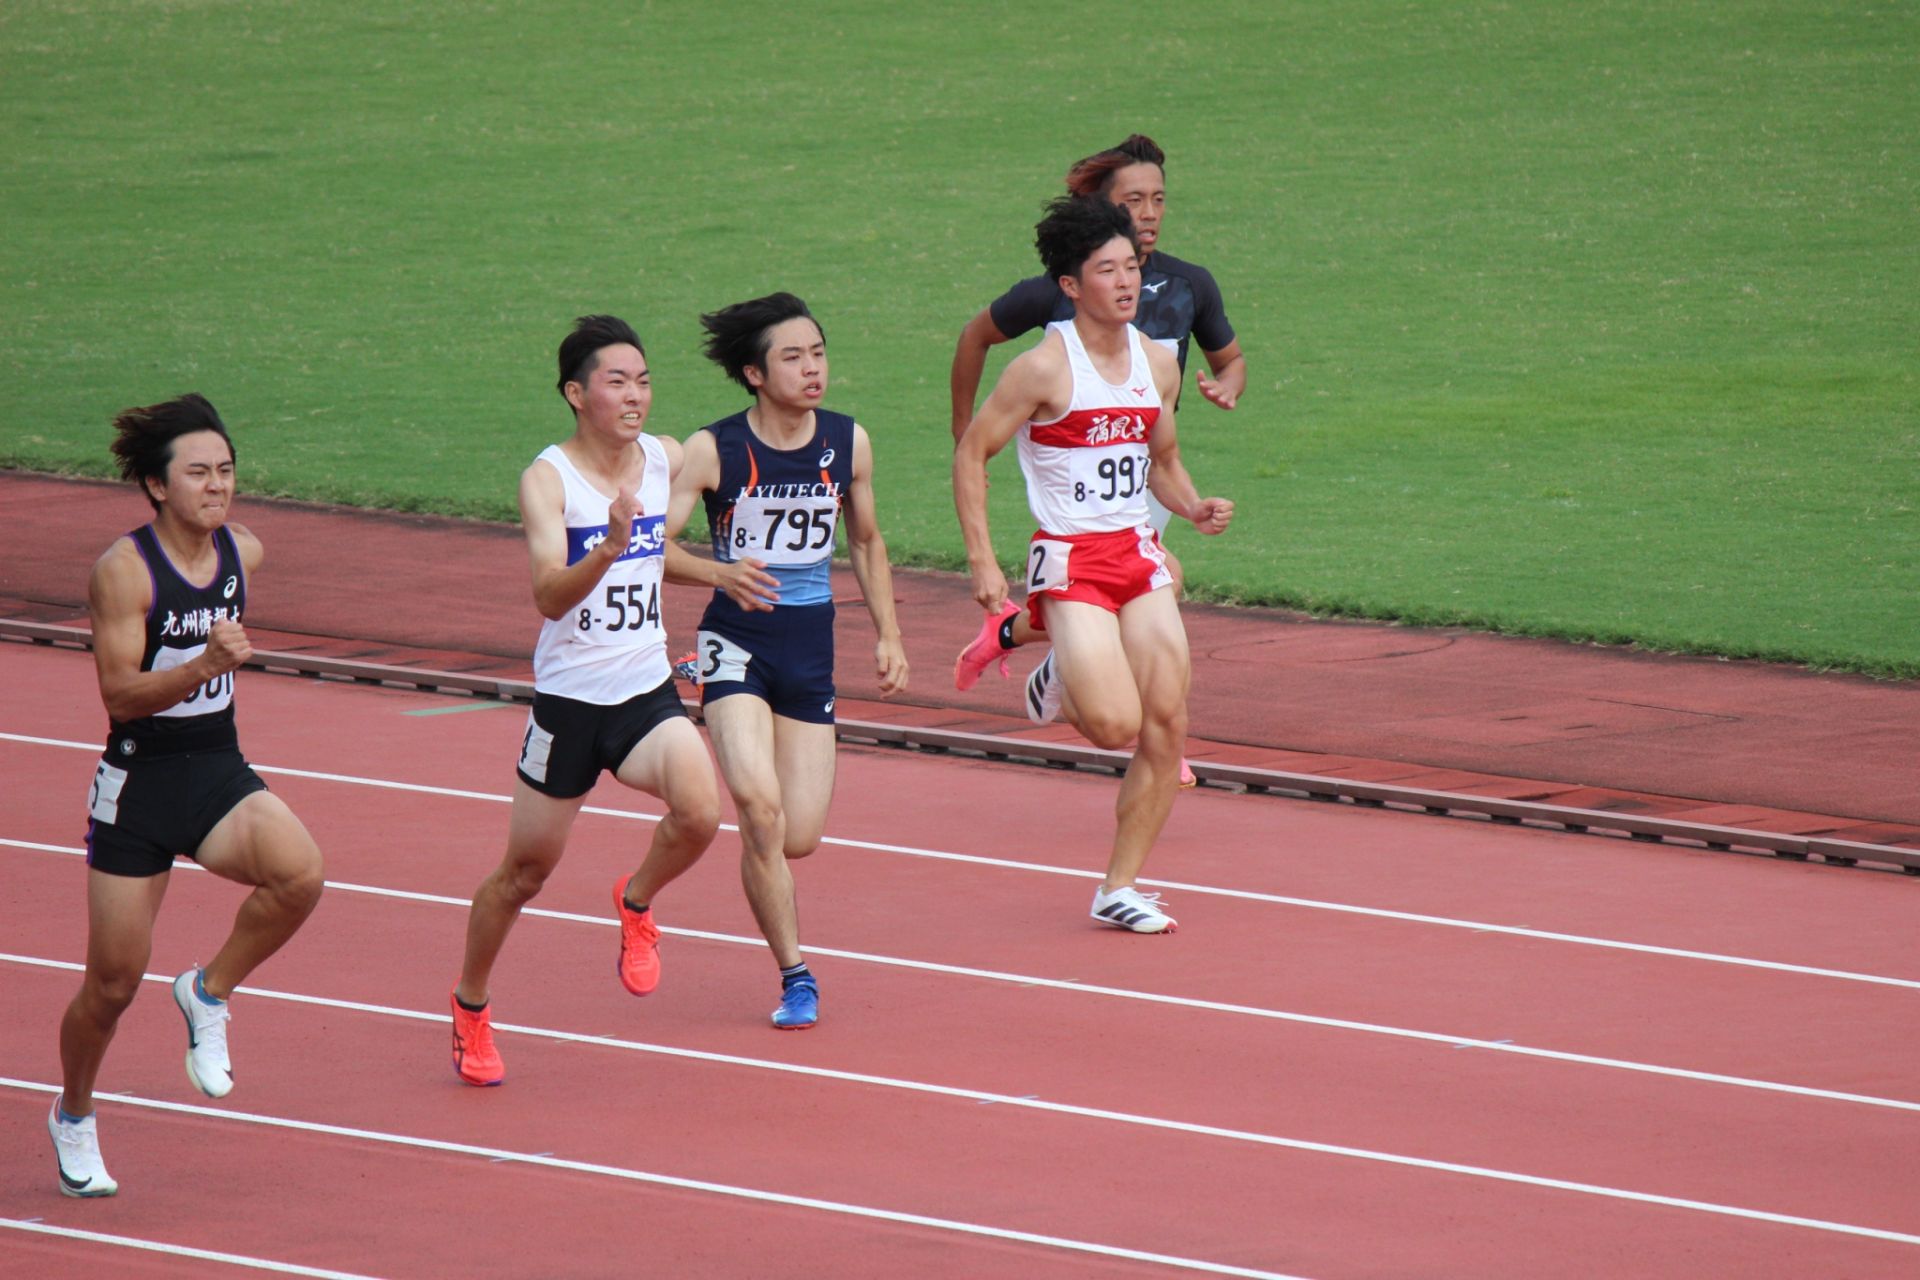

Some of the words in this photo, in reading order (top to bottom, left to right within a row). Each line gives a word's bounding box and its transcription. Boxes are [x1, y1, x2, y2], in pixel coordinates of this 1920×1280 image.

[1074, 455, 1149, 502] 8-997
[734, 508, 834, 552] 8-795
[1031, 545, 1047, 587] 2
[578, 582, 660, 632] 8-554
[702, 639, 724, 678] 3
